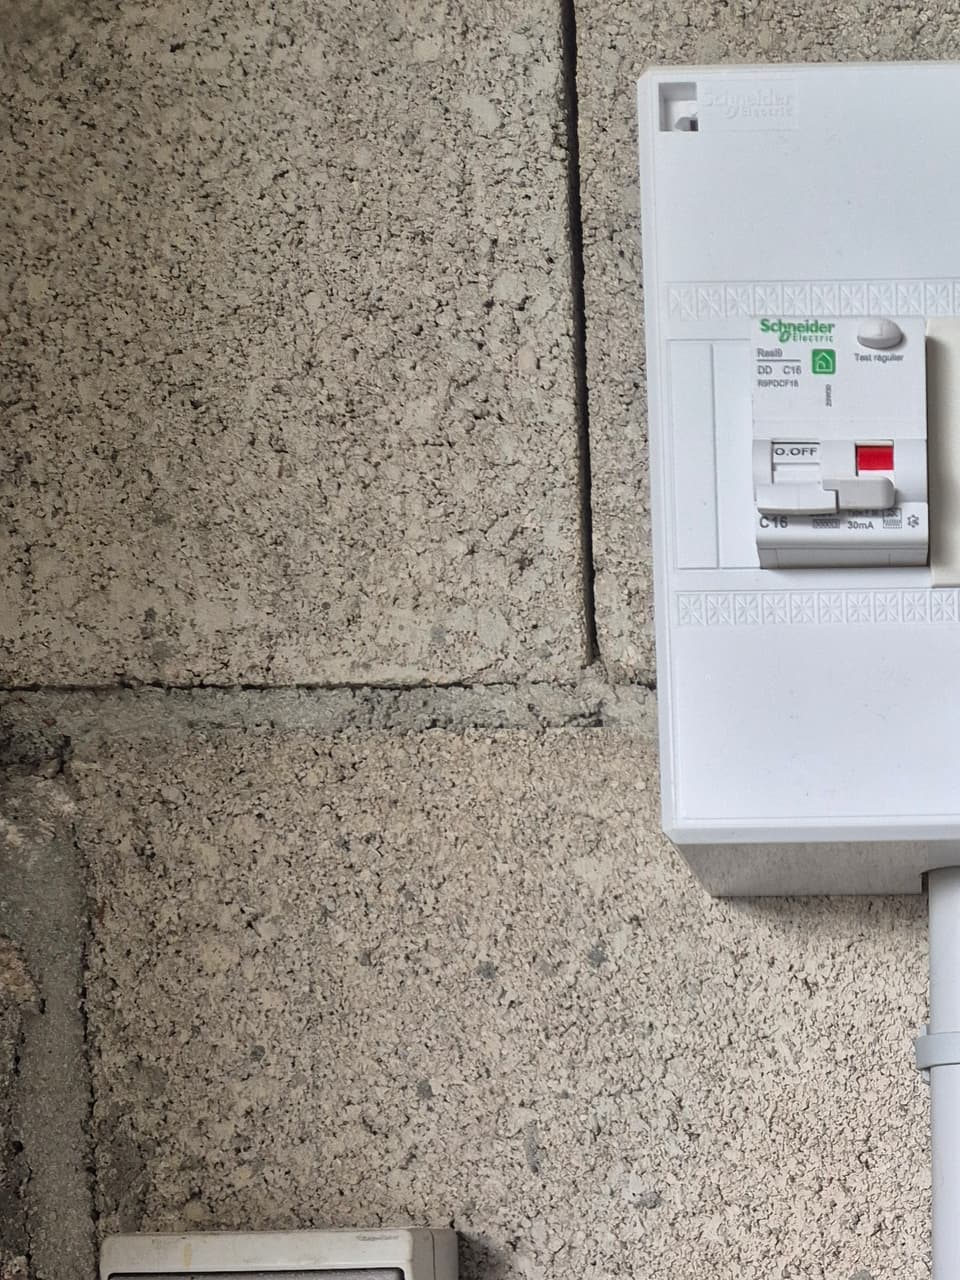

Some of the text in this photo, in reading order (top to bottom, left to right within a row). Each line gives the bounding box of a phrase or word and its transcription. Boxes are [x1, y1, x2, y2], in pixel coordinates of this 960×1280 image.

[760, 318, 835, 333] Schneider
[792, 334, 834, 342] Electric
[855, 353, 873, 361] Test
[757, 365, 802, 375] DD C16
[847, 520, 875, 530] 30mA
